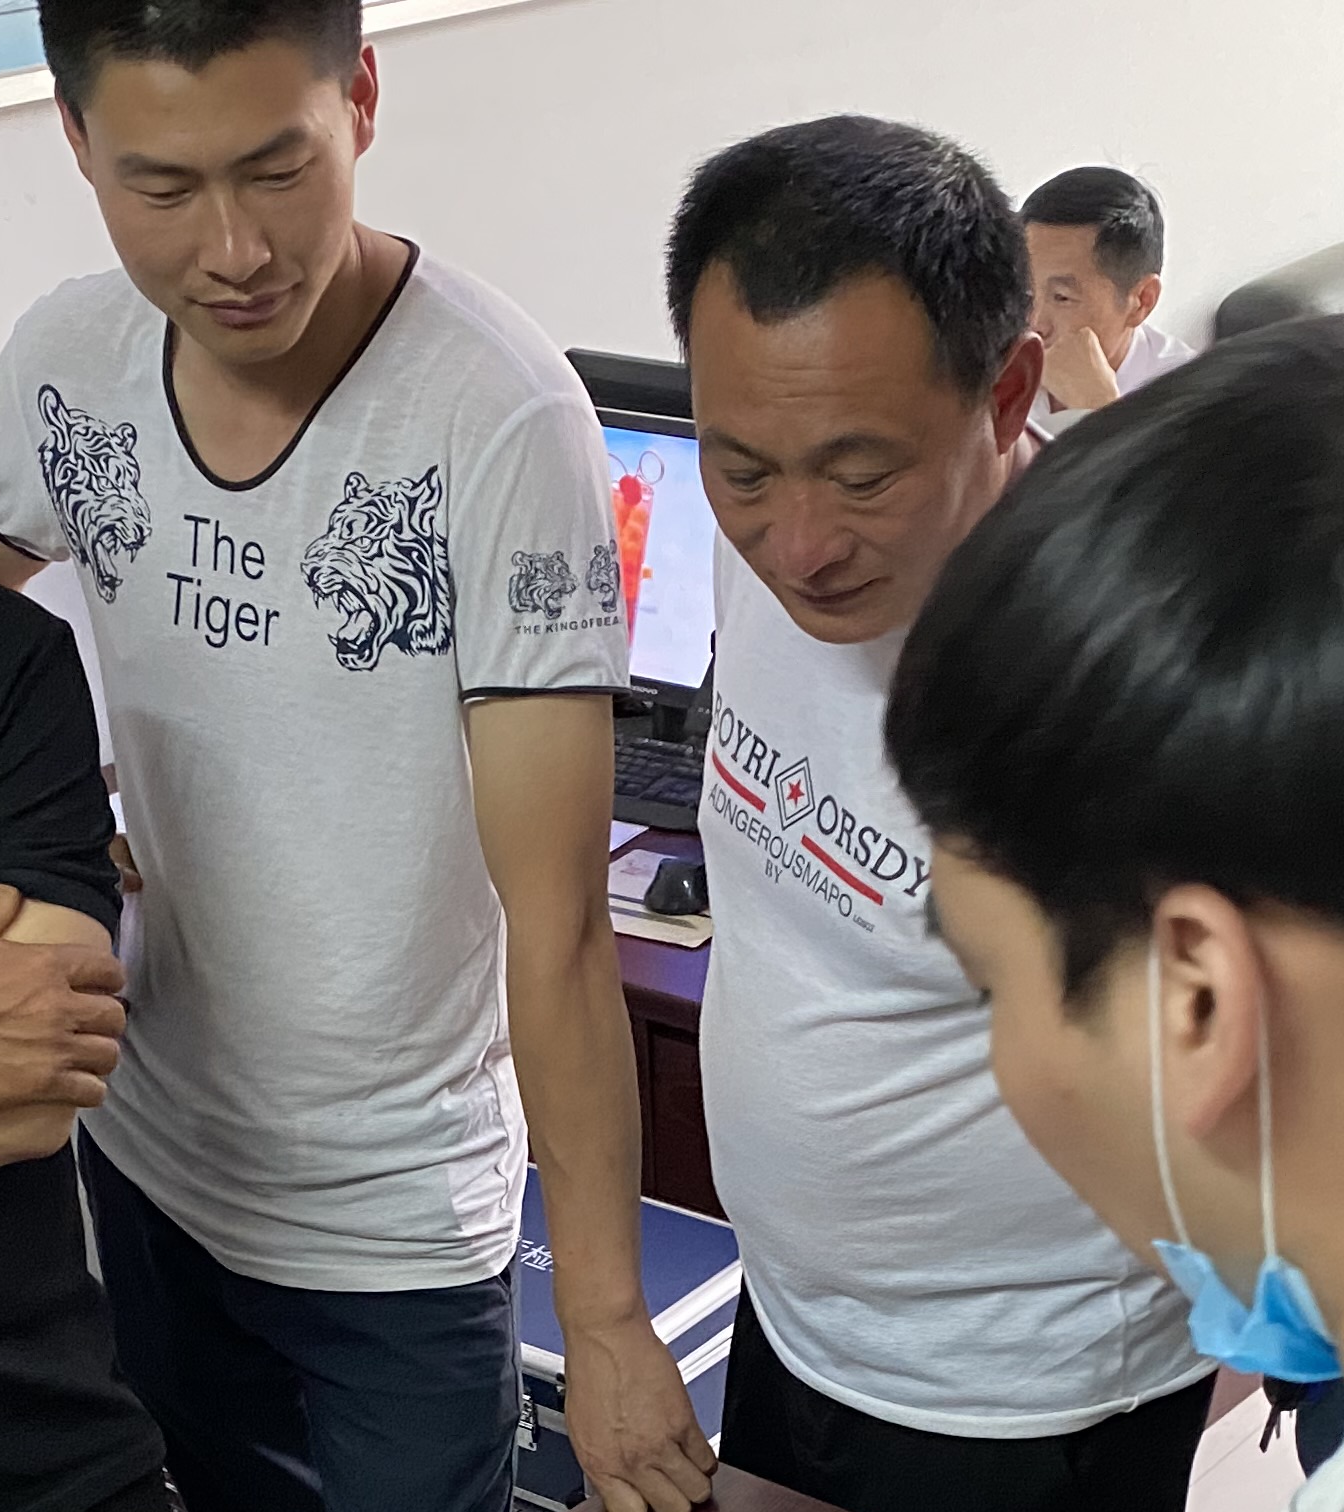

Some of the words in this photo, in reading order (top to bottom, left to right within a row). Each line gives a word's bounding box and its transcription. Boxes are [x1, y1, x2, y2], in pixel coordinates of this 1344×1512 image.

[183, 513, 266, 580] The
[166, 572, 280, 648] Tiger
[514, 625, 541, 635] THE
[546, 621, 578, 633] KING
[708, 783, 853, 918] ADNGEROUSMAPO
[765, 858, 783, 883] BY
[817, 794, 931, 898] ORSDY
